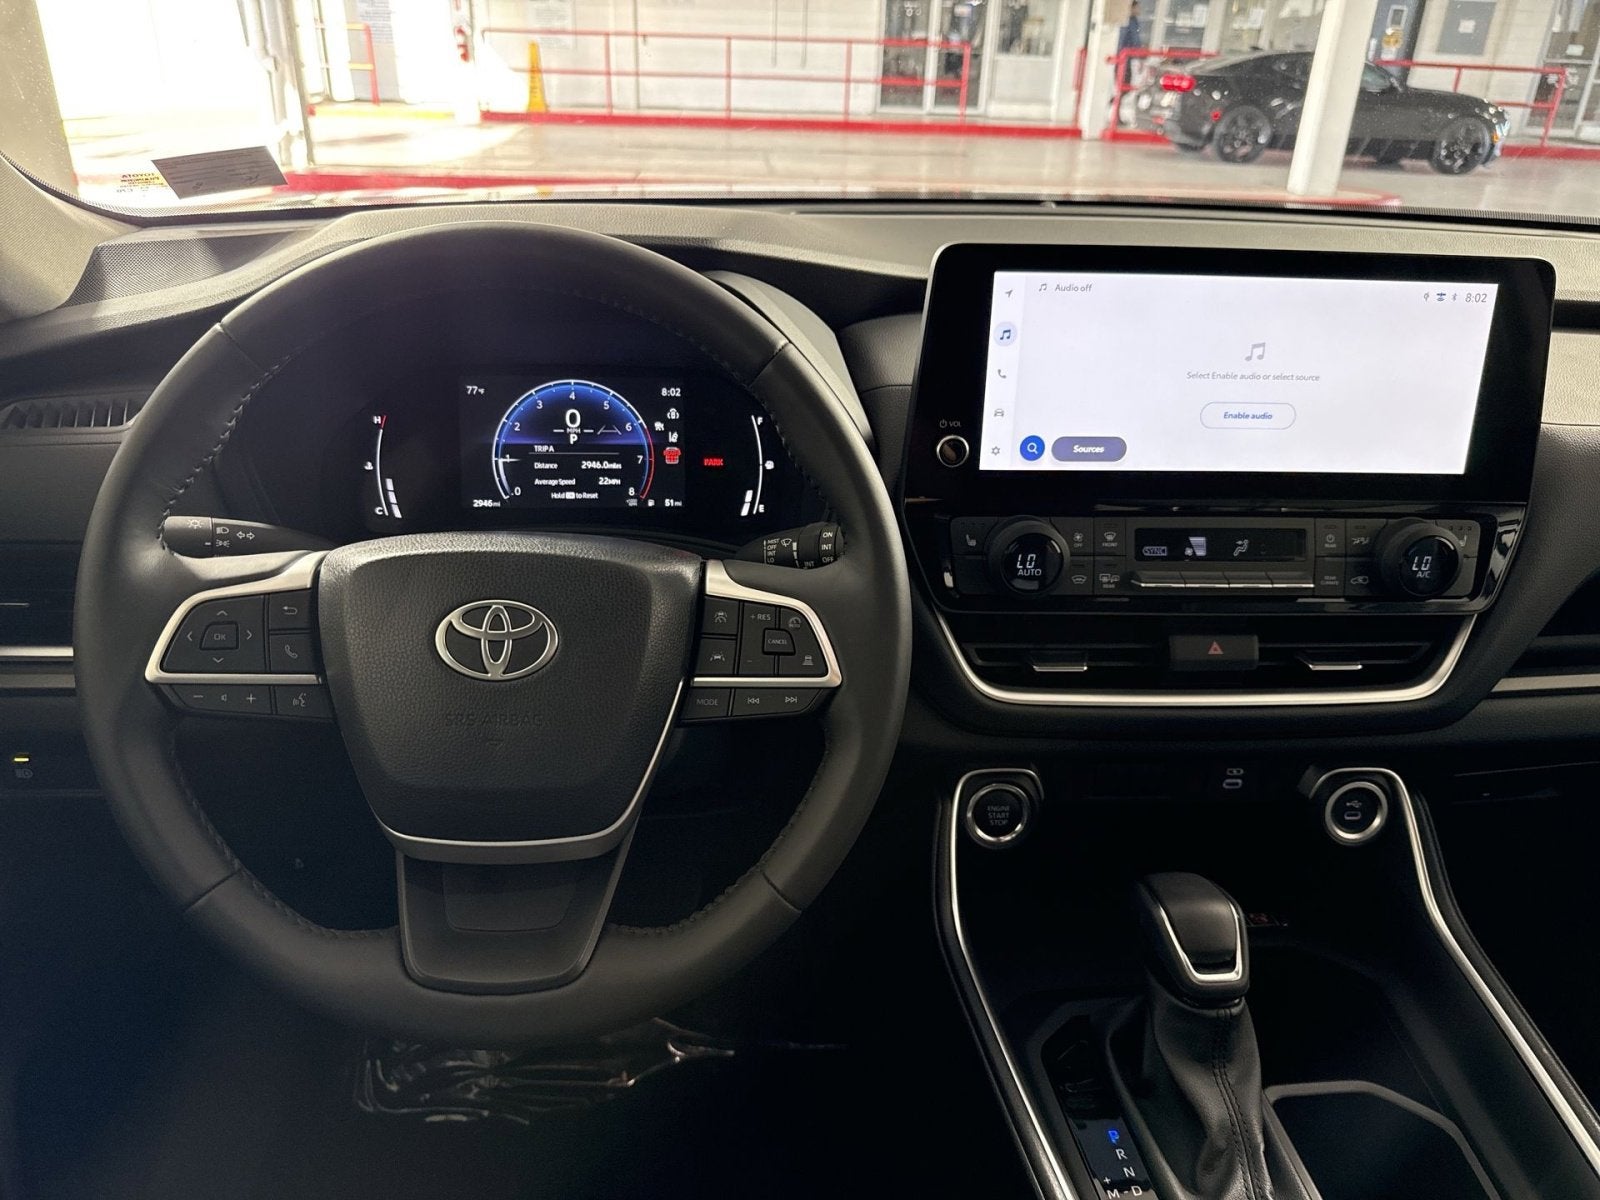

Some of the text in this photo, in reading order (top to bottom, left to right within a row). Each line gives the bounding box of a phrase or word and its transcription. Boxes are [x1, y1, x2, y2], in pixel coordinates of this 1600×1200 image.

[1054, 283, 1093, 293] Audio off
[1465, 293, 1488, 303] 8:02
[1186, 371, 1209, 380] Select
[1211, 371, 1238, 380] Enable
[1240, 372, 1261, 381] audio
[1272, 373, 1294, 381] select
[1295, 374, 1320, 382] source
[569, 391, 576, 400] 4
[661, 387, 682, 397] 8:02
[536, 400, 543, 409] 3
[603, 401, 610, 410] 5
[373, 415, 381, 424] H
[1223, 412, 1273, 420] Enable audio
[757, 417, 763, 425] F
[949, 420, 961, 428] VOL
[514, 422, 521, 431] 2
[625, 423, 632, 431] 6
[569, 433, 578, 444] P
[1072, 445, 1105, 454] Sources
[637, 455, 643, 464] 7
[703, 458, 723, 466] PARK
[514, 487, 521, 496] 0
[628, 487, 635, 496] 8
[375, 507, 383, 515] C
[758, 504, 764, 513] E
[1147, 547, 1166, 555] SYNC
[1016, 553, 1036, 569] LO
[1412, 556, 1431, 571] LO
[1017, 568, 1042, 576] AUTO
[213, 633, 226, 641] OK
[1108, 1130, 1120, 1144] P
[1115, 1148, 1128, 1160] R
[1123, 1166, 1135, 1178] N
[1106, 1185, 1143, 1199] M D
